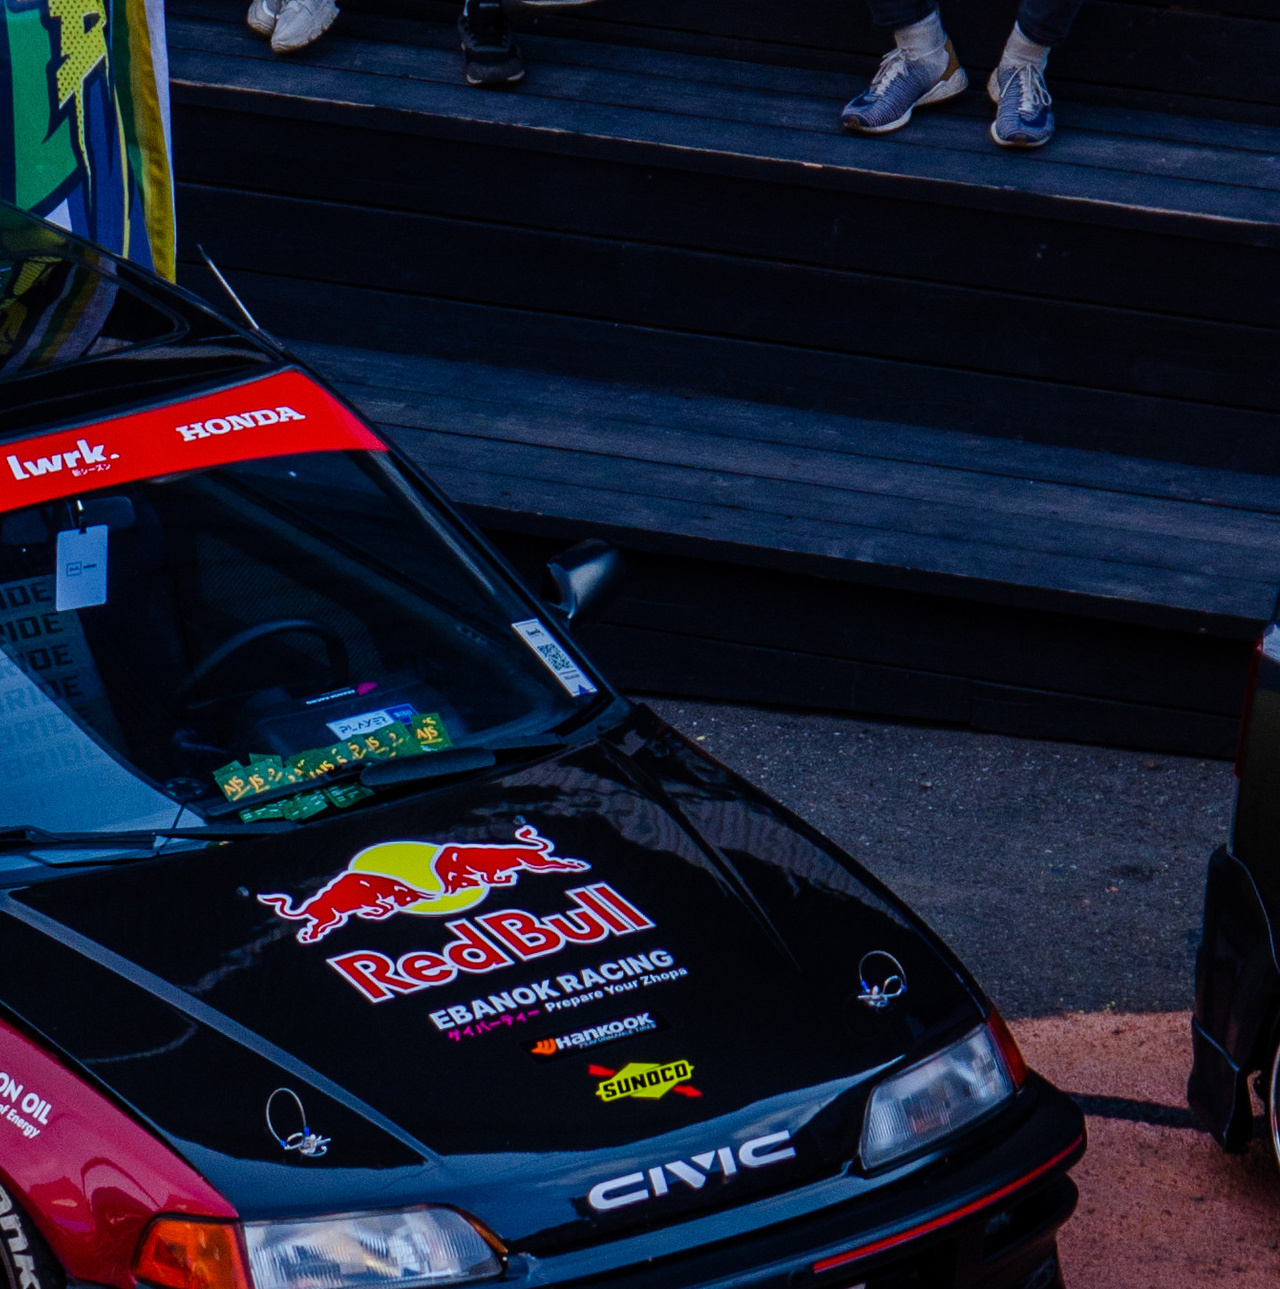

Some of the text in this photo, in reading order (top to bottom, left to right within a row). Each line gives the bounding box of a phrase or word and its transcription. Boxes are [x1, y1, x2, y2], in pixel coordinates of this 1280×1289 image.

[176, 405, 306, 444] HONDA
[327, 881, 656, 1003] Red Bull
[428, 948, 675, 1032] EBANOK RACING
[544, 966, 688, 1014] Prepare Your Zhopa
[602, 1063, 689, 1099] SUNOCO
[6, 1108, 41, 1140] Energy
[20, 1091, 52, 1125] OIL
[588, 1130, 797, 1212] CIVIC
